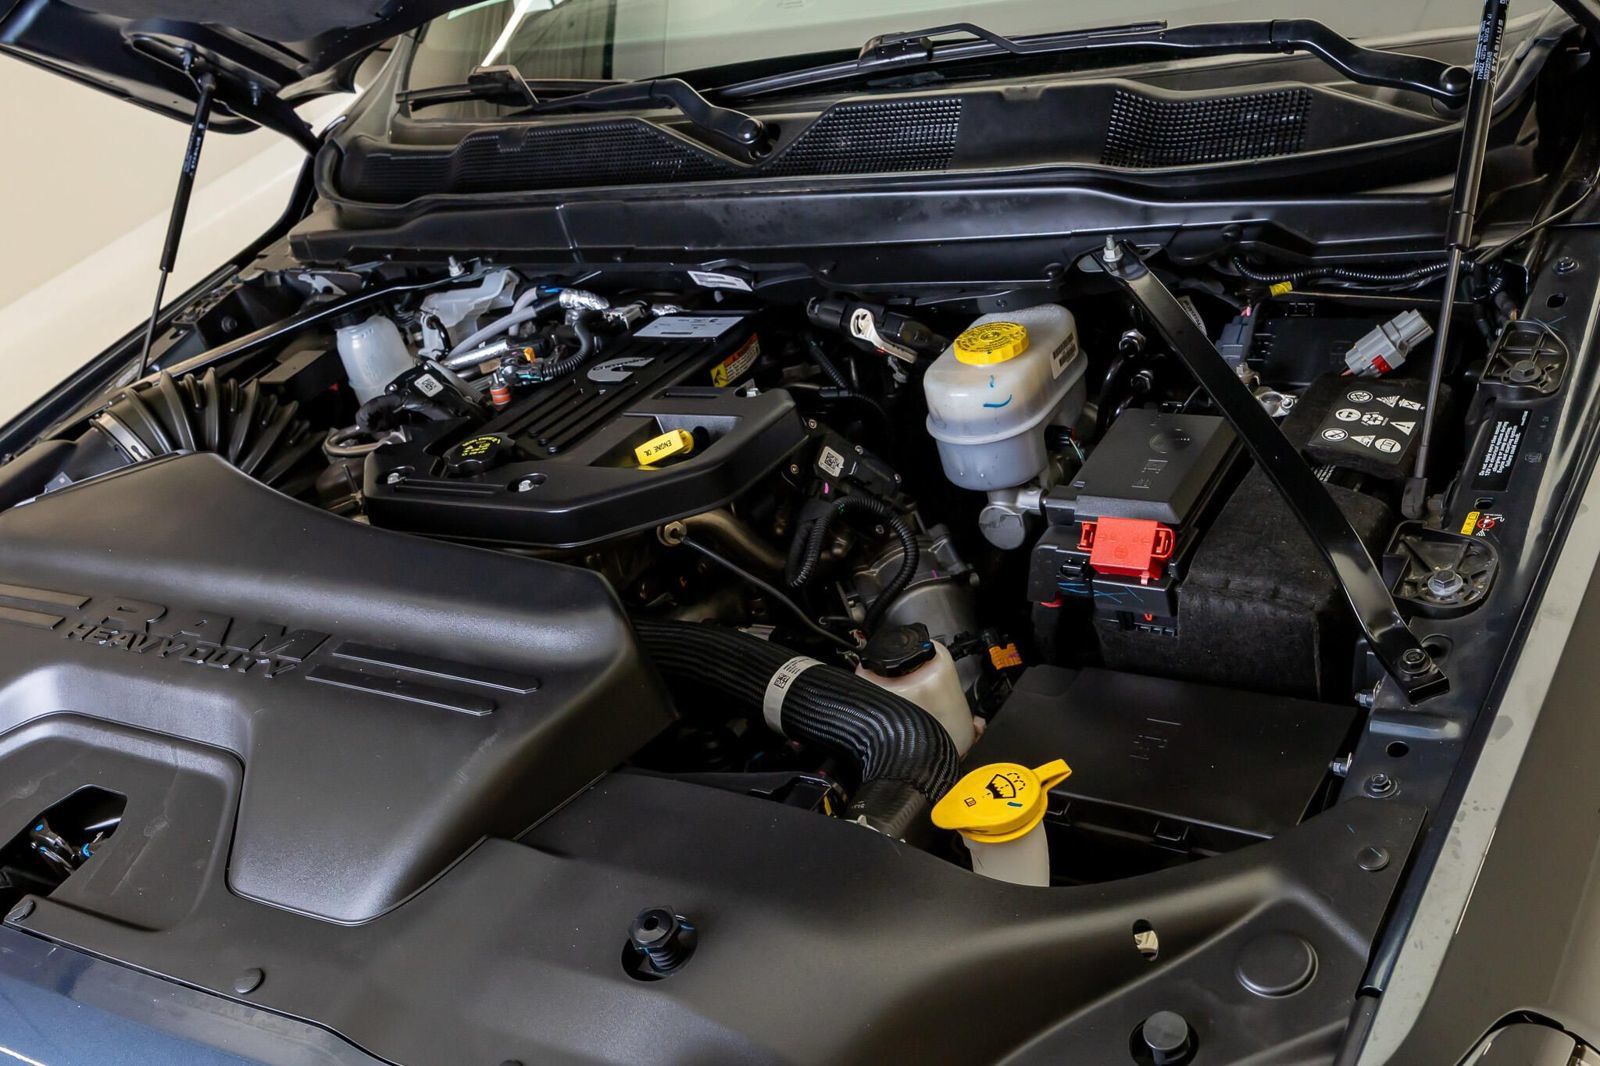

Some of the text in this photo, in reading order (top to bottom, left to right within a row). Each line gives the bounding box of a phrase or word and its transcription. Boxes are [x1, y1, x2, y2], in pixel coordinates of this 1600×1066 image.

[1491, 19, 1504, 72] STABILUS
[653, 440, 672, 453] ENGINE
[64, 623, 299, 679] HEAVY DUTY
[101, 600, 332, 662] RAM
